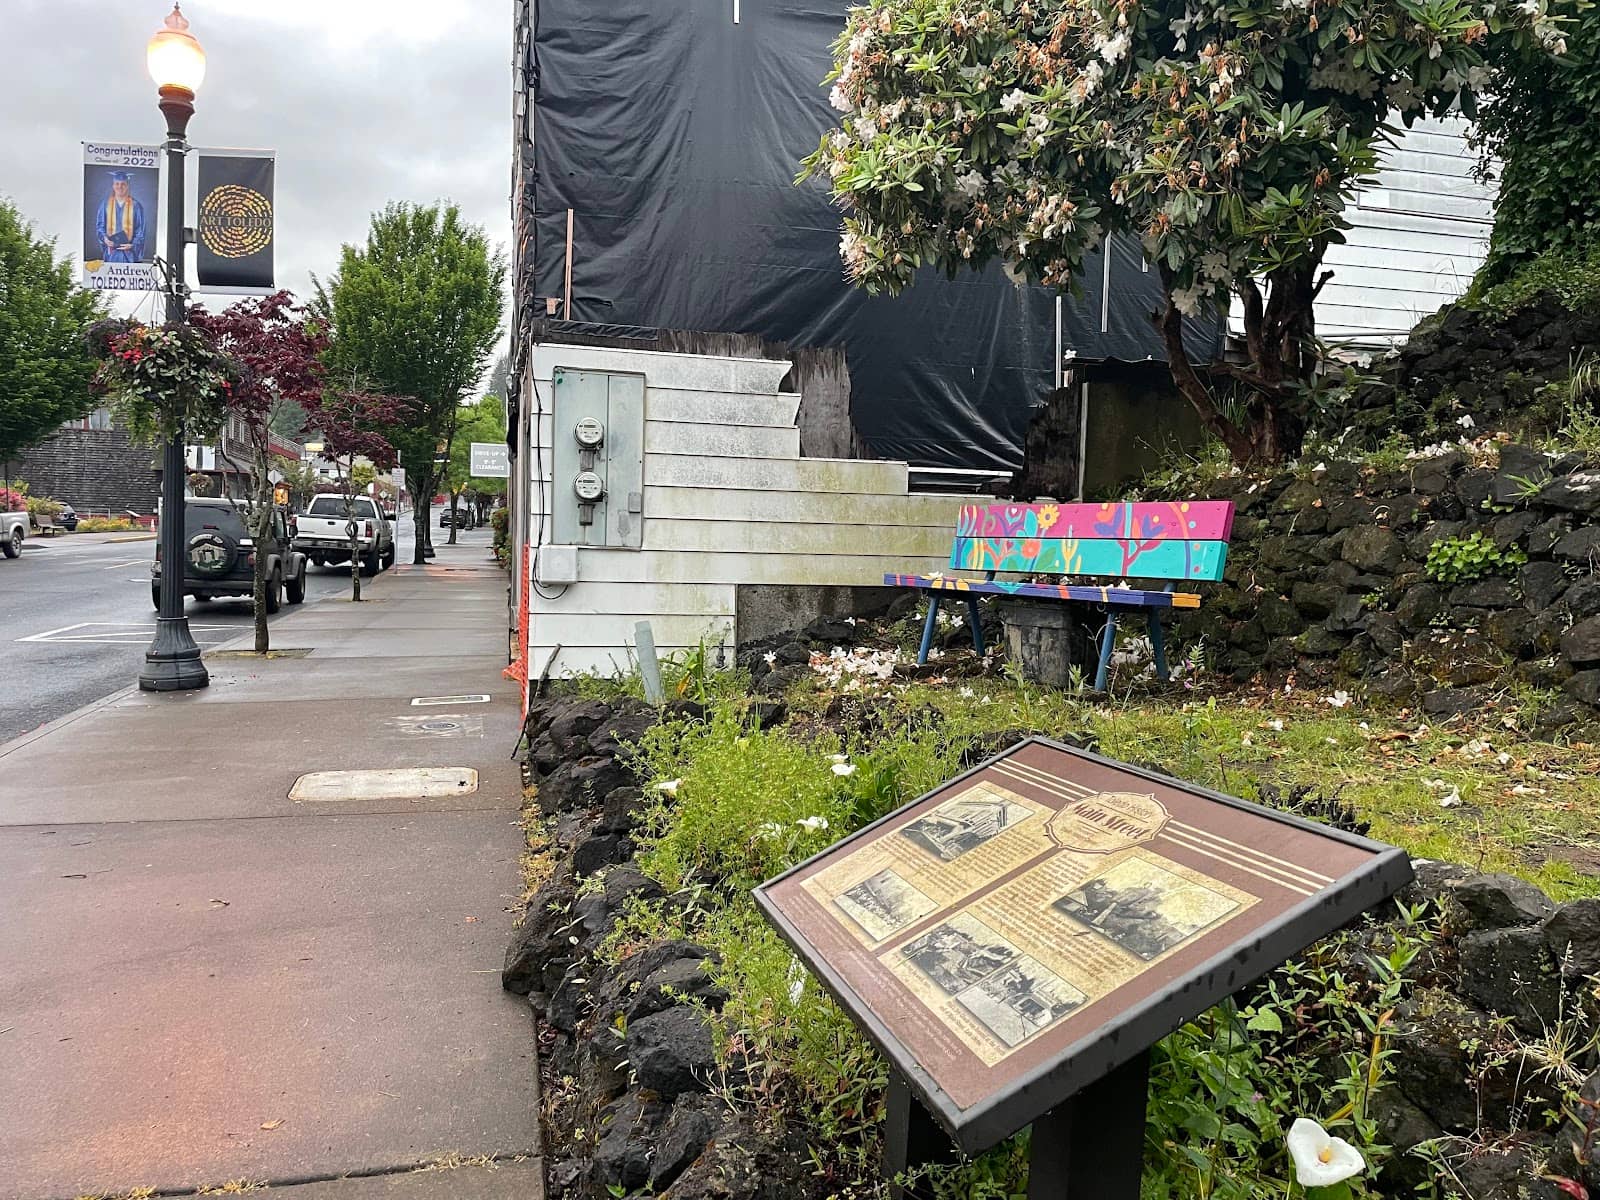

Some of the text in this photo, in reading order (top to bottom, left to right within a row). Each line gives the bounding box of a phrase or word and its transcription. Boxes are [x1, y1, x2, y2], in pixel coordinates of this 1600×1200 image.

[87, 144, 158, 157] Congratulations
[123, 157, 154, 166] 2022
[200, 216, 271, 227] ART TOLEDO
[108, 265, 150, 276] Andrew
[91, 276, 152, 290] TOLEDO HIGH
[1073, 803, 1108, 822] Main
[1102, 815, 1152, 839] Street
